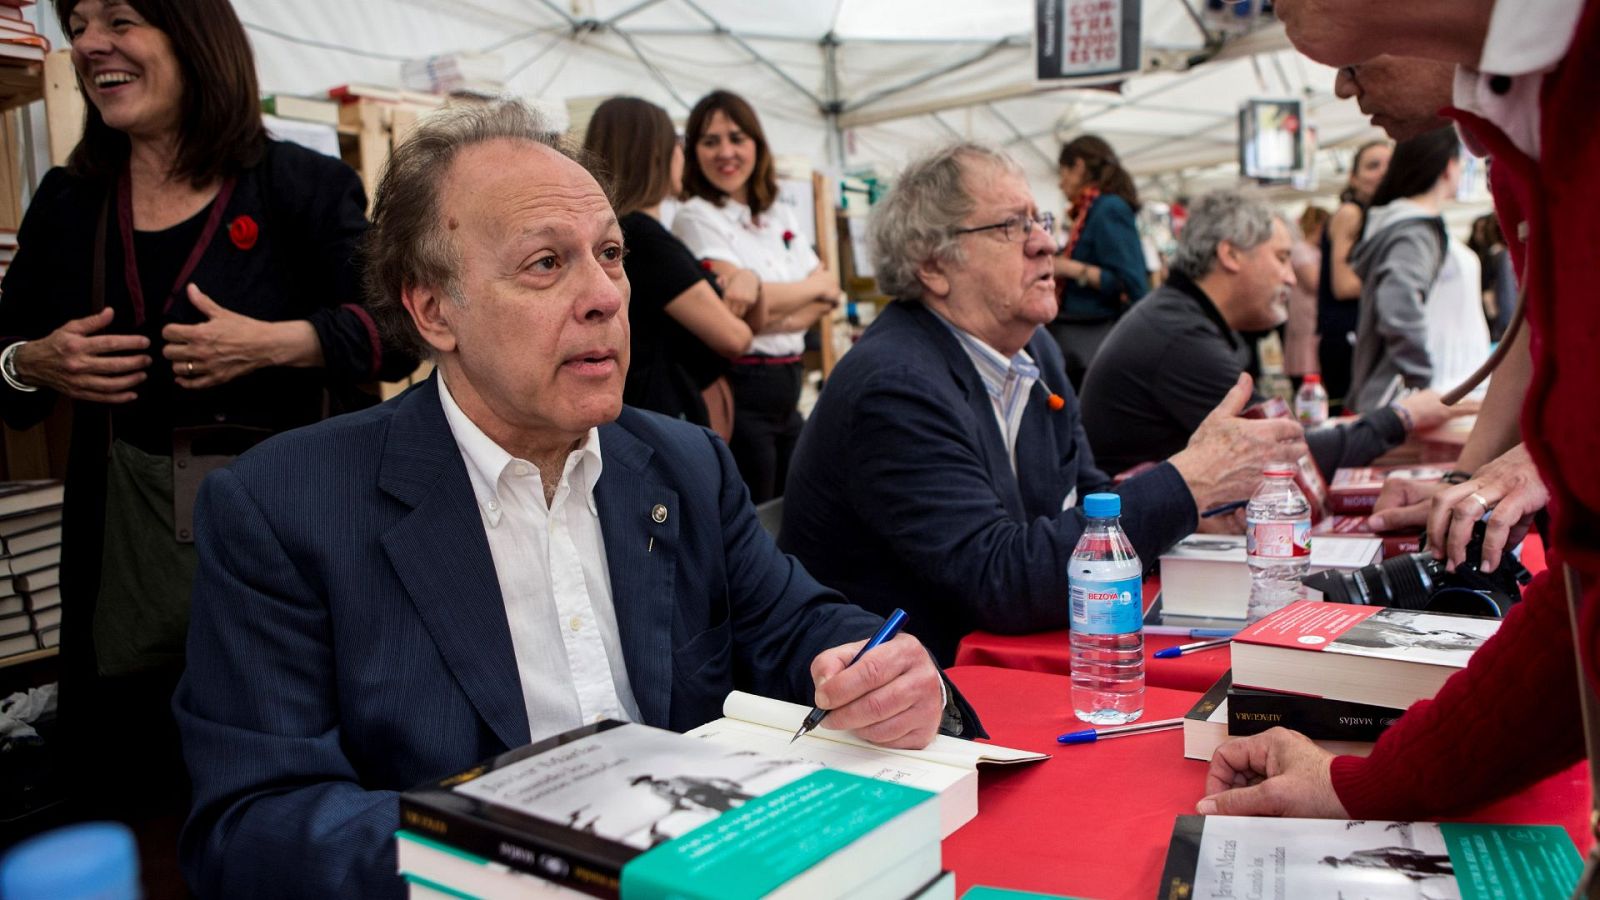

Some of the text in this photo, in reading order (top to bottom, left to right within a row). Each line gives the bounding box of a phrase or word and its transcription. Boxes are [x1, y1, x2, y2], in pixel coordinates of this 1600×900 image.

[1069, 46, 1116, 64] ESTO
[1235, 712, 1282, 722] ALFAGUARA
[1339, 715, 1373, 727] MARÍAS
[1216, 839, 1238, 868] Marías
